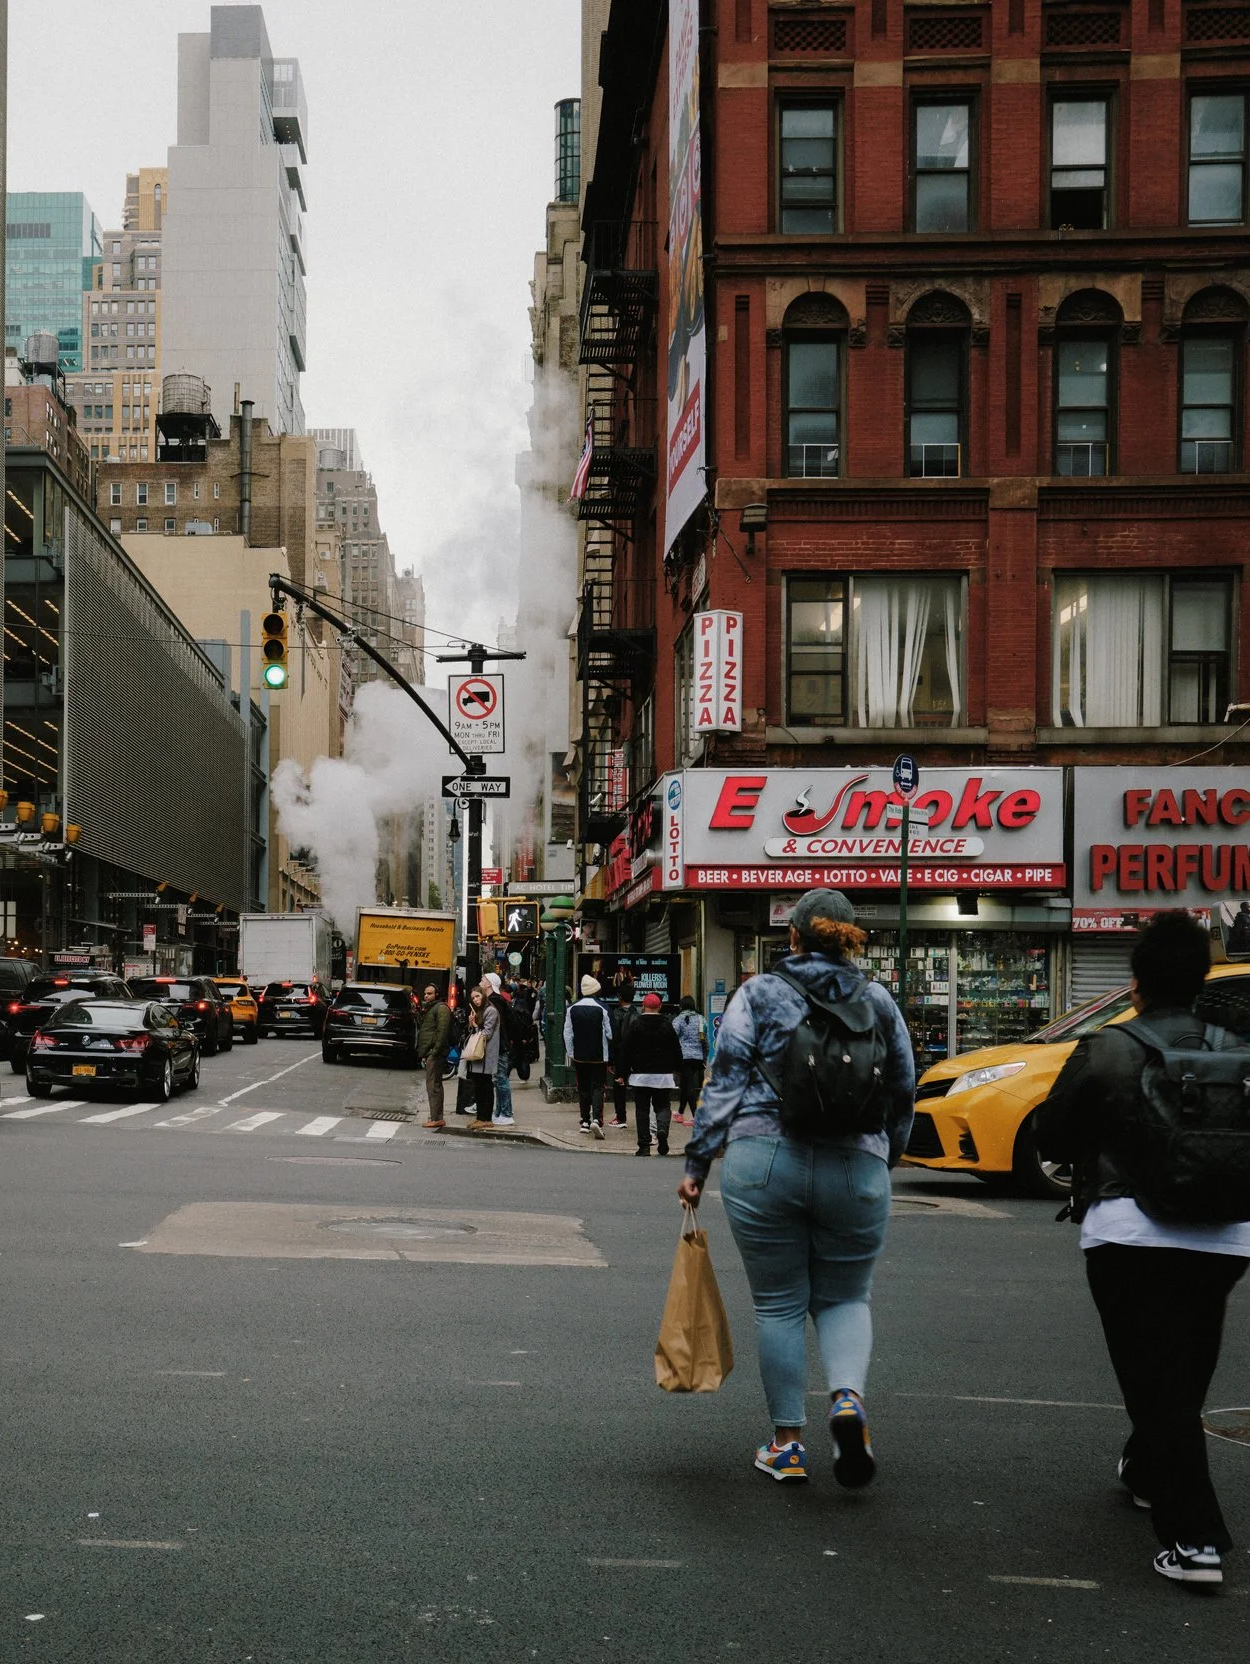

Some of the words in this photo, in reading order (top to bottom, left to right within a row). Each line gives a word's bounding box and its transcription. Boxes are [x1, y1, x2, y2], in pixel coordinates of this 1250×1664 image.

[698, 616, 714, 726] PIZZA
[723, 615, 738, 726] PIZZA
[454, 721, 472, 730] 9AM
[482, 721, 501, 730] 5PM
[454, 731, 470, 739] MON
[487, 730, 500, 738] FRI
[452, 783, 472, 792] ONE
[481, 783, 502, 792] WAY
[1124, 788, 1250, 827] FANC
[668, 815, 680, 881] LOTTO
[782, 838, 797, 854] &
[806, 838, 967, 854] CONVENENCE
[698, 870, 729, 883] BEER
[741, 870, 812, 883] BEVERAGE
[824, 869, 867, 883] LOTTO
[924, 869, 932, 882] E
[935, 869, 958, 882] CIG
[970, 869, 1012, 882] CIGAR
[1025, 868, 1052, 882] PIPE
[515, 882, 527, 891] AC
[529, 882, 556, 891] HOTEL
[369, 922, 397, 930] Household
[1072, 917, 1098, 929] 70%
[1100, 917, 1125, 928] OFF
[640, 973, 662, 981] KILLERS
[633, 980, 653, 988] FLOWER
[653, 980, 668, 988] MOON
